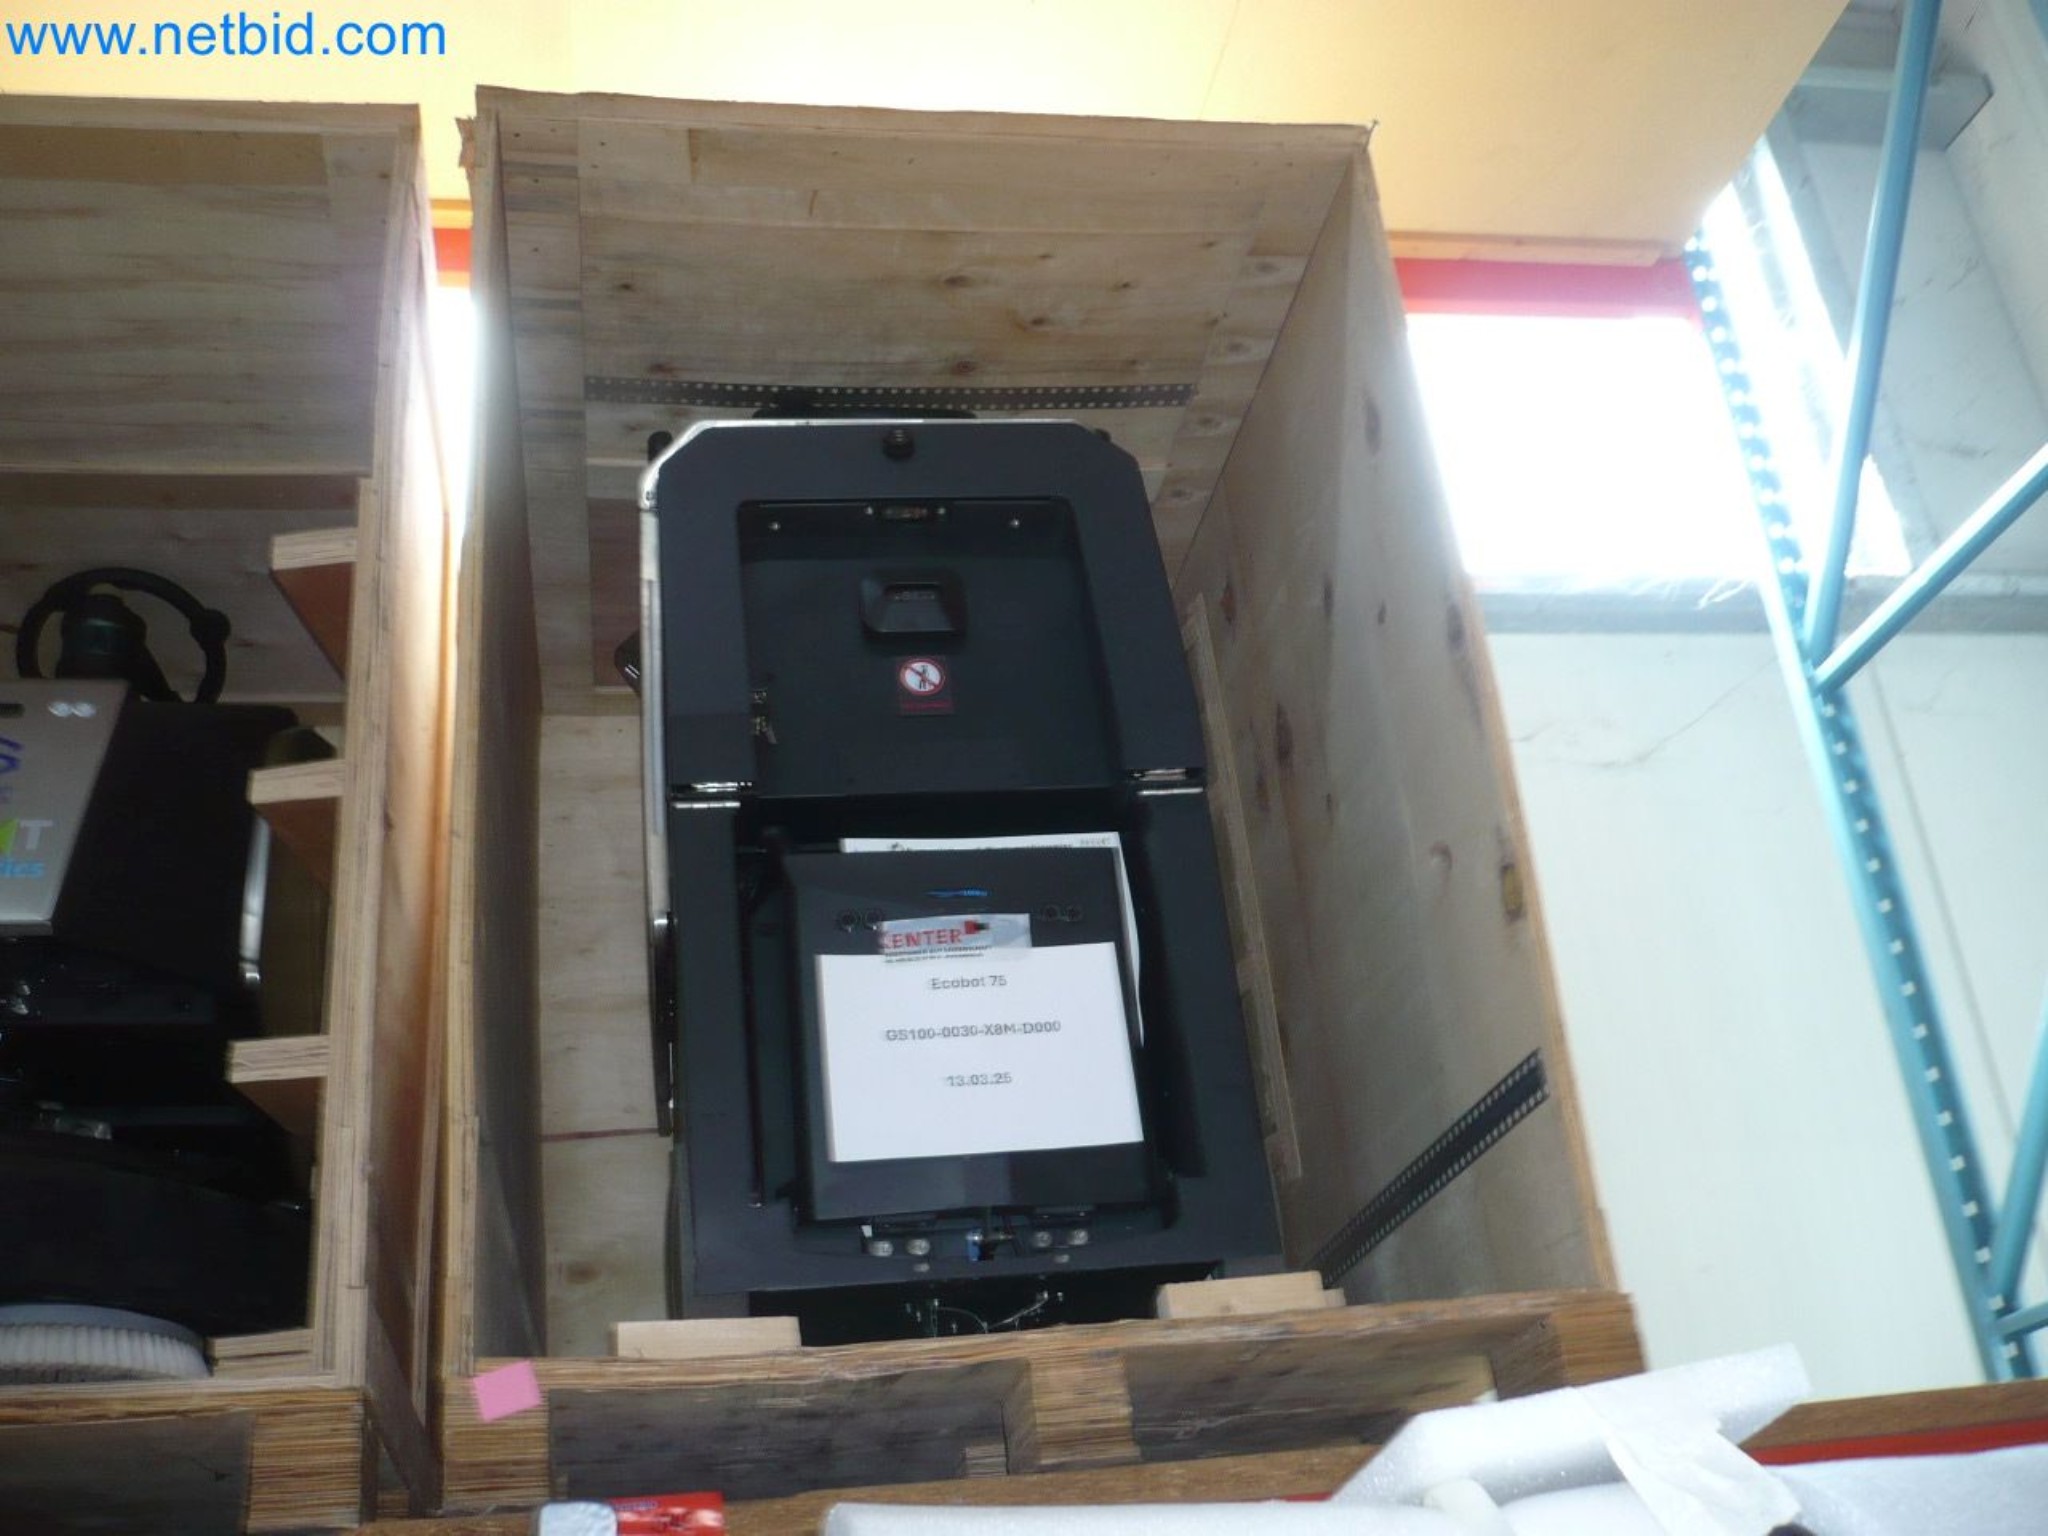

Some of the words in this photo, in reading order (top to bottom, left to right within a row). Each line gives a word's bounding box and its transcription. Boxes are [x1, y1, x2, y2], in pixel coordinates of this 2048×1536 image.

[931, 976, 985, 990] Ecobot
[989, 974, 1007, 987] 75
[946, 1072, 1013, 1087] 13.03.25
